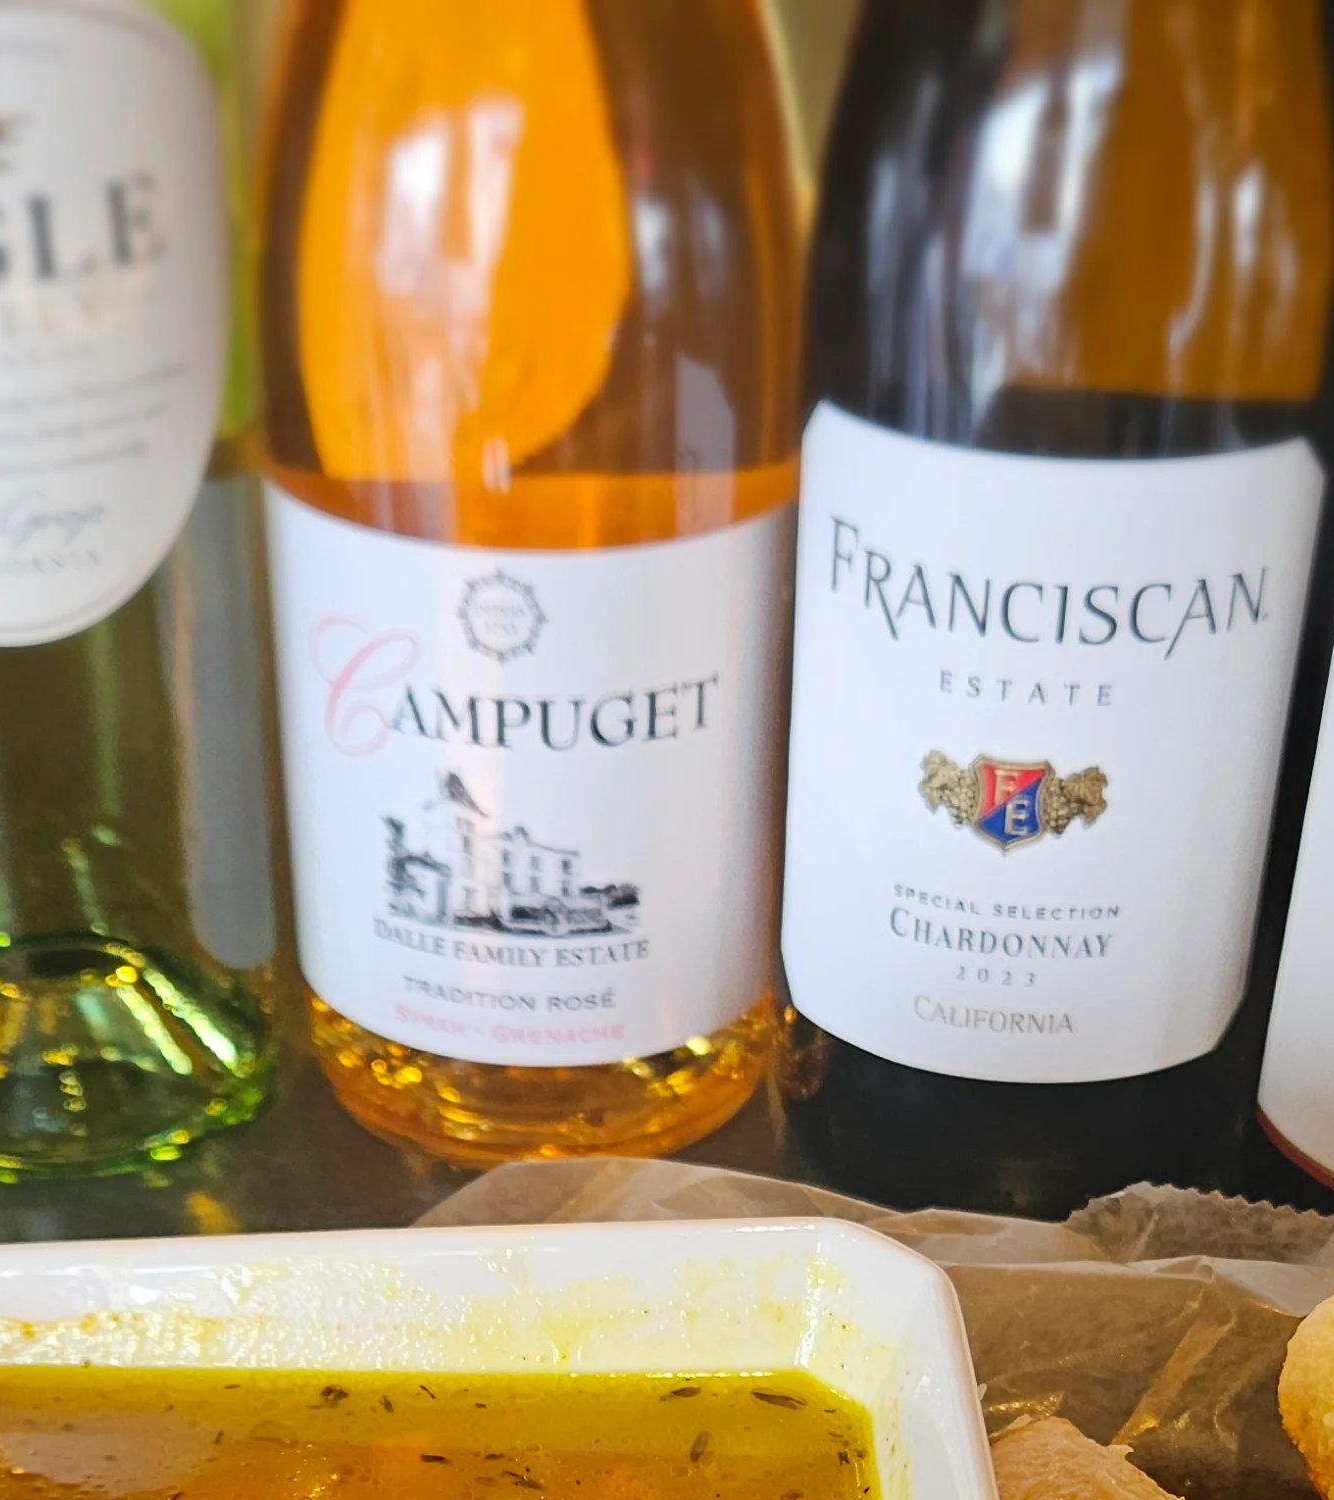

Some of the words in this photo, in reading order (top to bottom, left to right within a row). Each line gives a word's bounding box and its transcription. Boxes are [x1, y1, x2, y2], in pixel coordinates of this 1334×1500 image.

[831, 516, 1269, 660] FRANCISCAN
[310, 612, 719, 757] CAMPUGET
[940, 670, 1112, 706] ESTATE
[893, 883, 981, 915] SPECIAL
[992, 903, 1121, 920] SELECTION
[889, 906, 1115, 959] CHARDONNAY
[452, 940, 548, 967] FAMILY
[555, 939, 650, 966] ESTATE
[403, 974, 535, 1012] TRADITION
[547, 987, 616, 1012] ROSÉ
[955, 965, 1036, 987] 2023
[913, 994, 1075, 1035] CALIFORNIA
